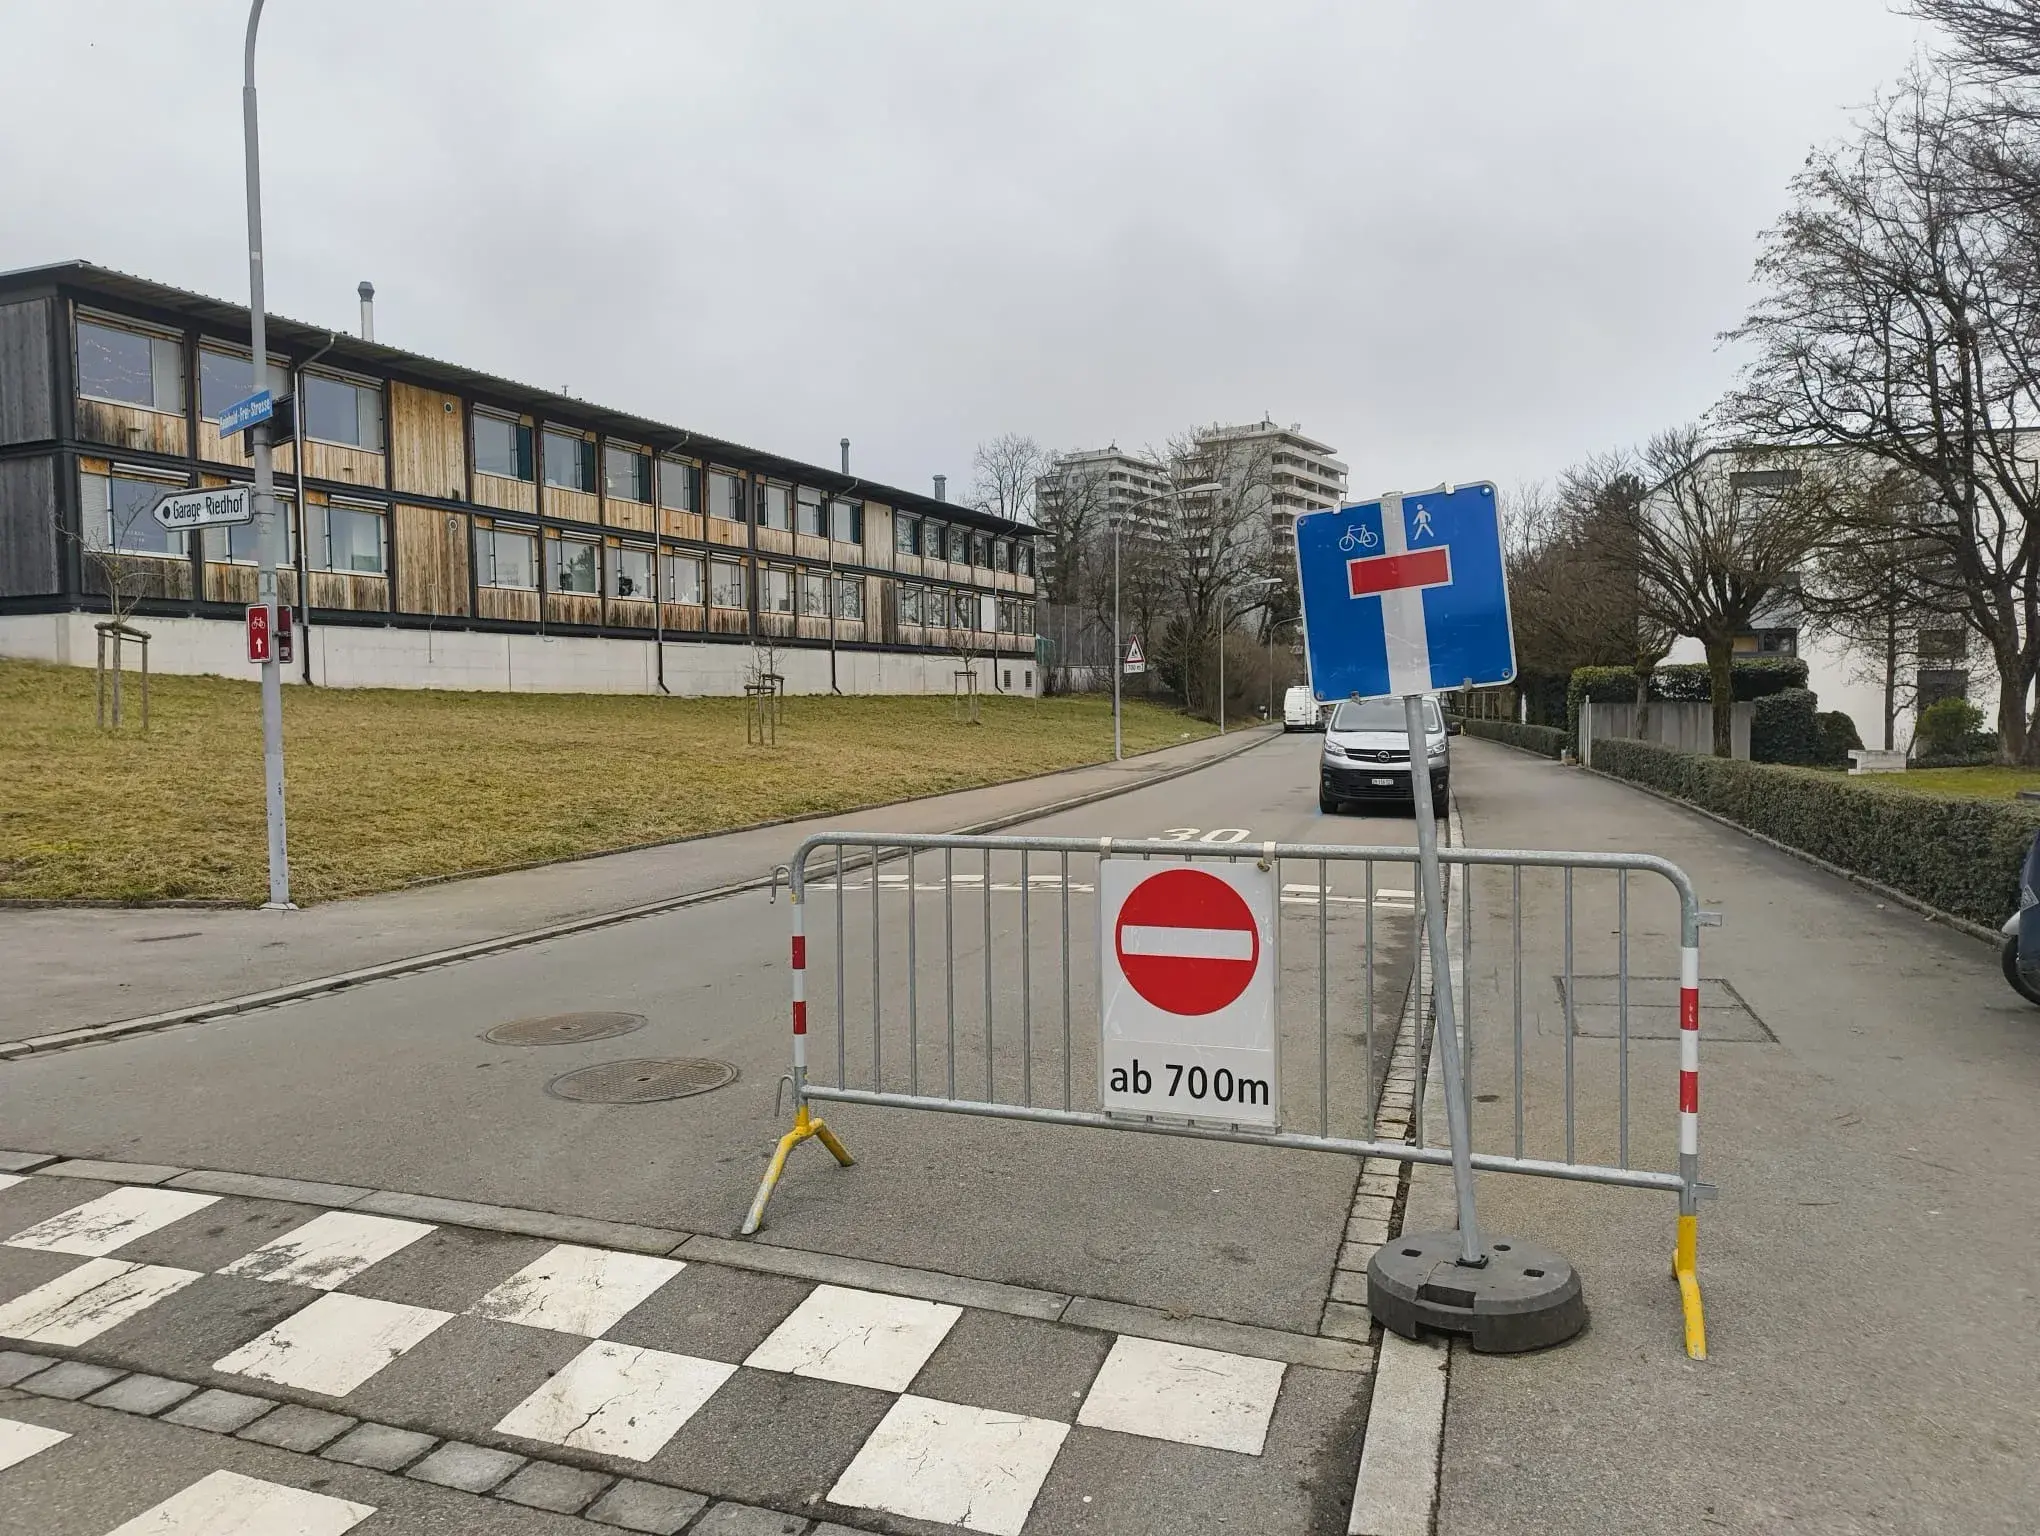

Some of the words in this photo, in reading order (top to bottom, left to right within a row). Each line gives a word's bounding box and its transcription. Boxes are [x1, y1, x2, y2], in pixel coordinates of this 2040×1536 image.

[173, 501, 201, 522] Garage
[206, 493, 243, 515] Riedhof
[1147, 828, 1251, 843] 30
[1110, 1059, 1152, 1095] ab
[1165, 1064, 1269, 1106] 700m
